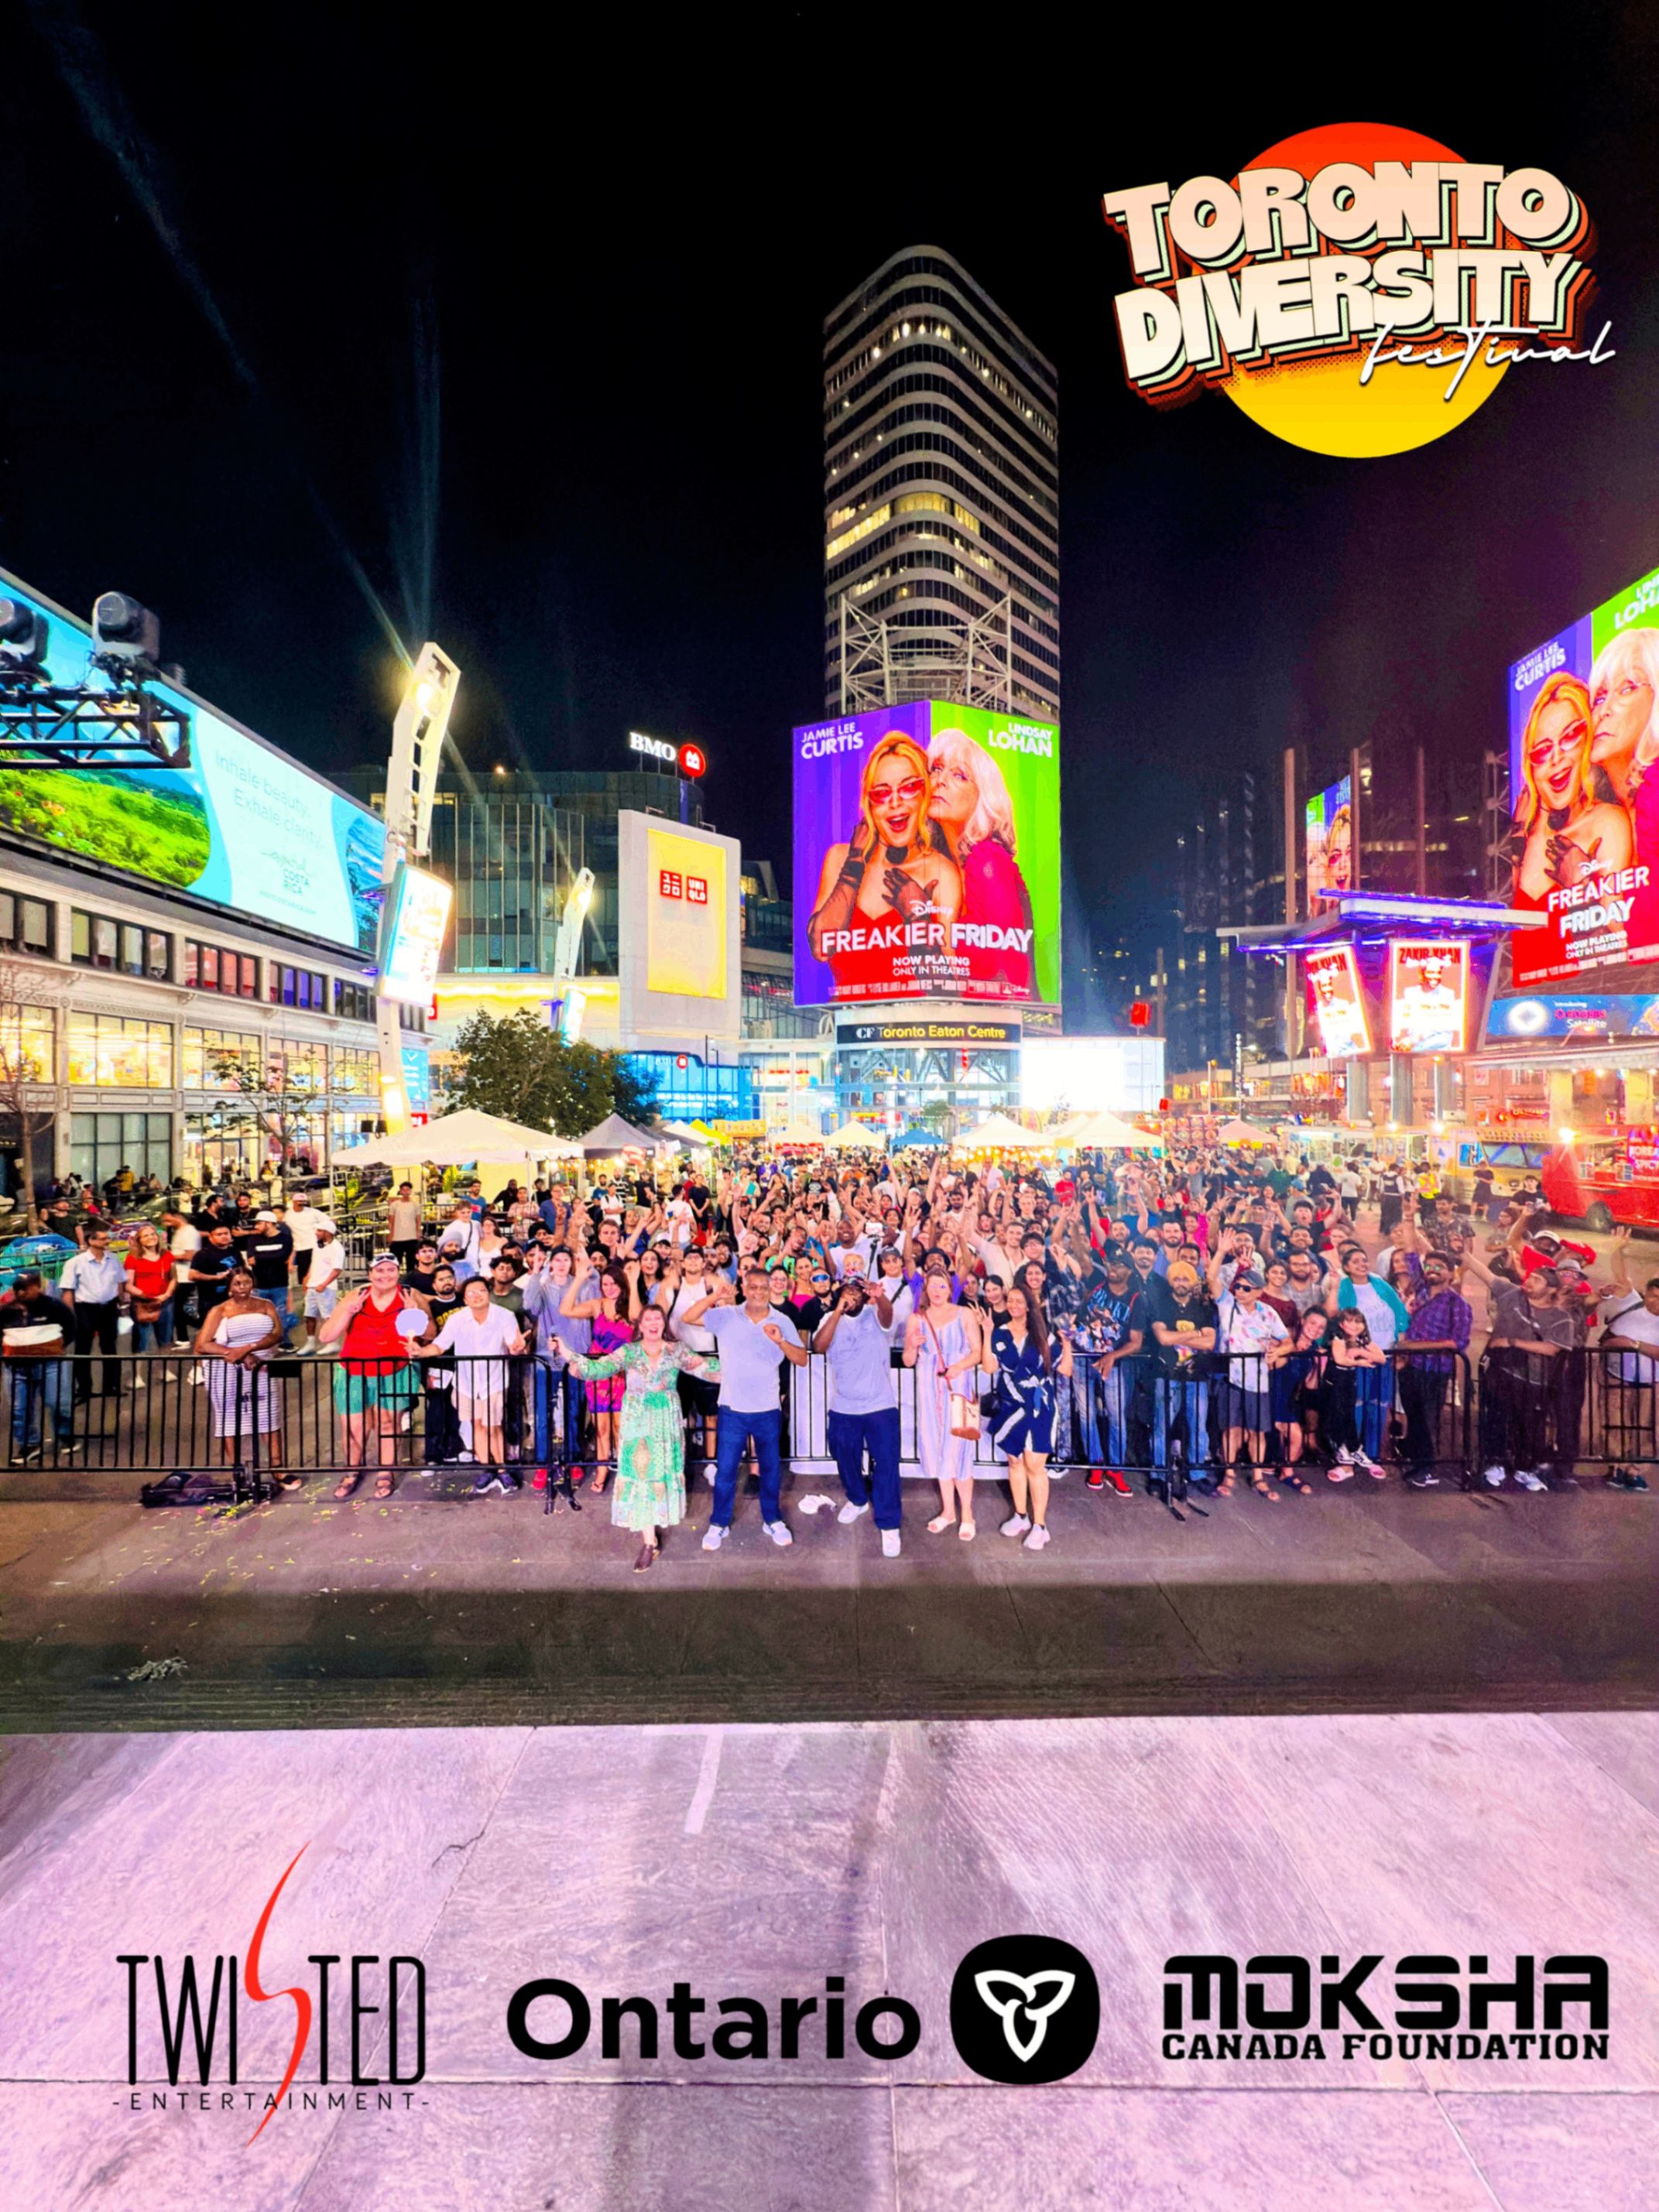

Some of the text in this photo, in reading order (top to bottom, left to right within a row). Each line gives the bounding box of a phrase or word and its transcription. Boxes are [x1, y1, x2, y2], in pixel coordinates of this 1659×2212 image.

[1514, 647, 1566, 691] CURTIS
[1516, 642, 1559, 676] JAMIE LEE
[801, 731, 864, 759] CURTIS
[802, 722, 855, 742] JAMIE LEE
[988, 729, 1053, 758] LOHAN
[1008, 722, 1053, 741] LINDSAY
[629, 731, 677, 762] BMO
[1548, 866, 1649, 912] FREAKIER
[1560, 896, 1635, 938] FRIDAY
[821, 922, 1033, 954] FREAKIER FRIDAY
[893, 954, 970, 967] NOW PLAYING
[893, 966, 970, 976] ONLY IN THEATRES
[855, 1025, 1006, 1039] CF Toronto Eaton Centre
